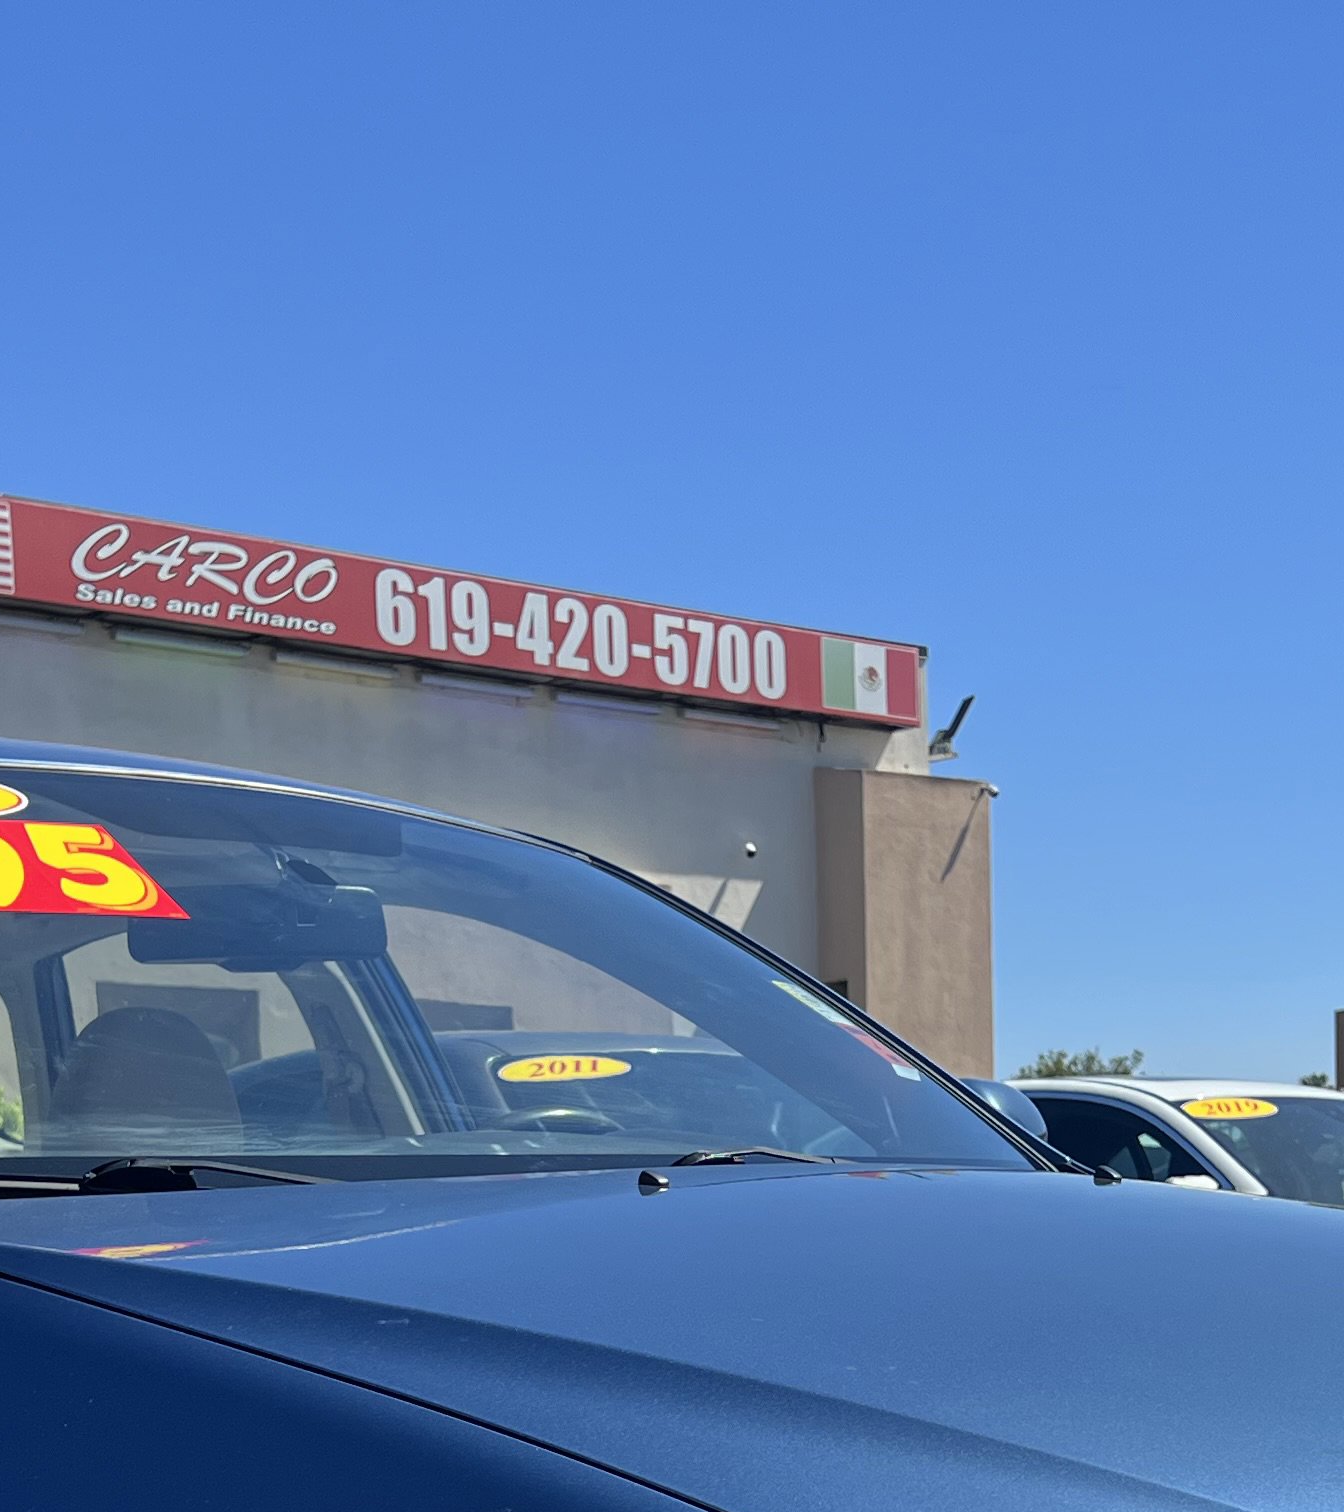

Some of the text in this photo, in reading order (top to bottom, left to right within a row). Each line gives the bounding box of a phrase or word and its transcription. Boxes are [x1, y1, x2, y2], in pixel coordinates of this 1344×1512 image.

[71, 523, 338, 605] CARCO
[75, 583, 337, 635] Sales and Finance
[374, 568, 787, 699] 619-420-5700
[528, 1058, 600, 1078] 2011
[1201, 1100, 1260, 1116] 2019
